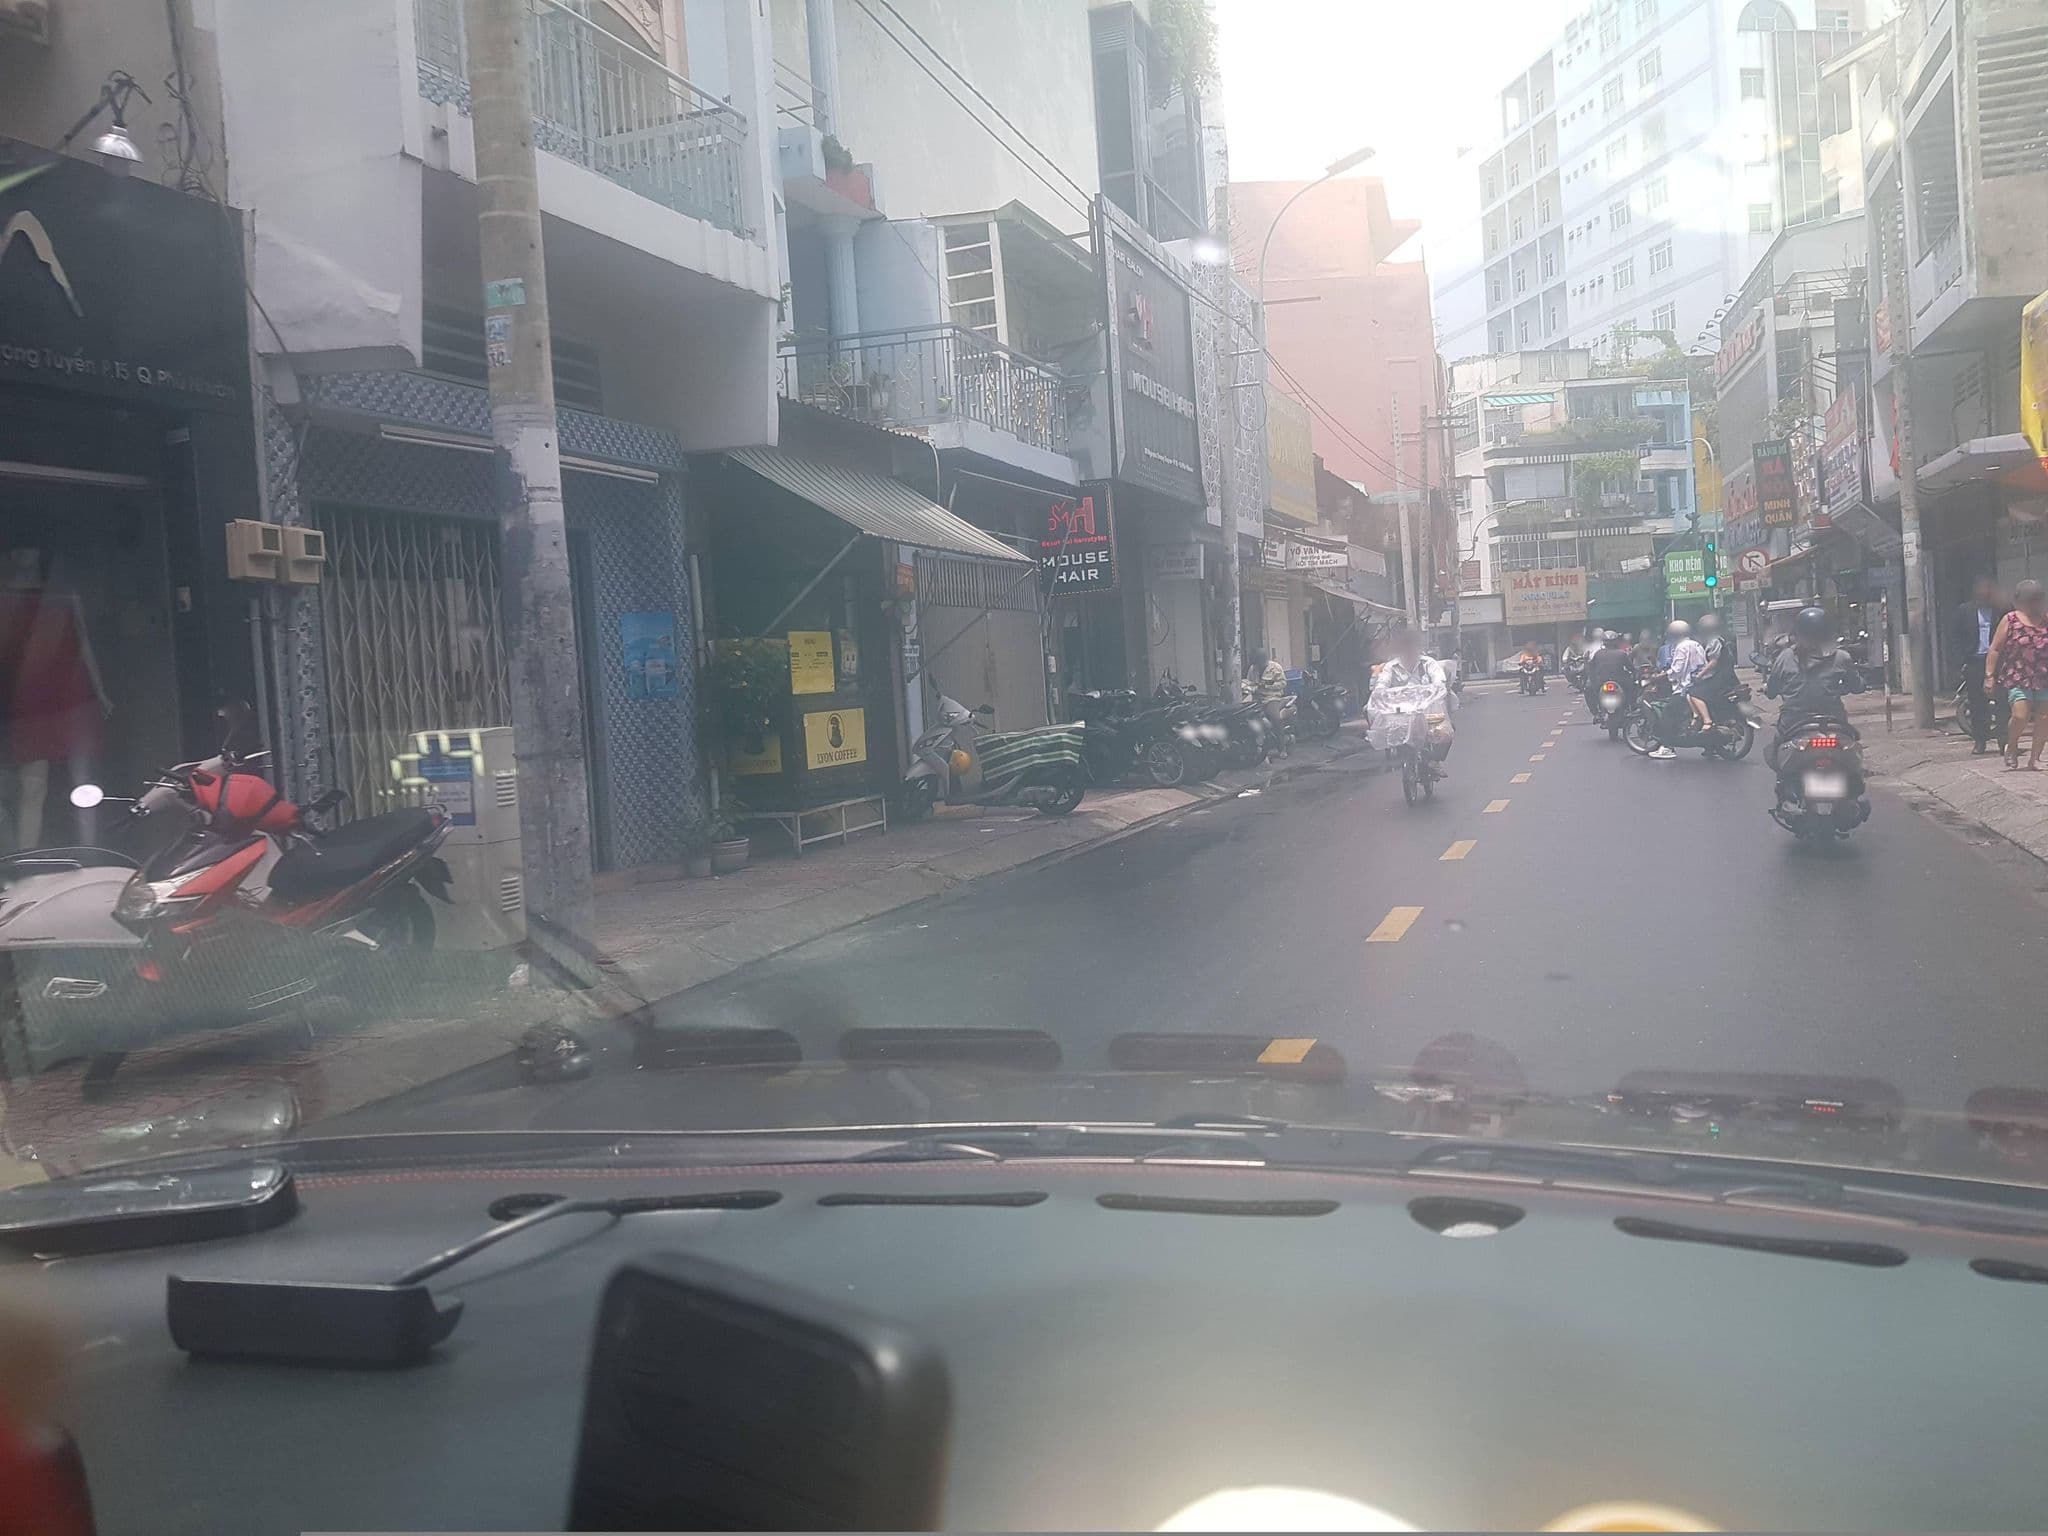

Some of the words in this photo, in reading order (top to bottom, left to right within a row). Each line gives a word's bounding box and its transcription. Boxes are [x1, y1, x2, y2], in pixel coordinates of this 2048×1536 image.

[1127, 370, 1171, 411] MOUSE
[1172, 390, 1196, 421] HAIR
[1763, 499, 1790, 511] MINH
[1042, 551, 1109, 569] MOUSE
[1669, 559, 1684, 572] KHO
[1055, 569, 1099, 584] HAIR
[834, 748, 858, 762] COFFEE
